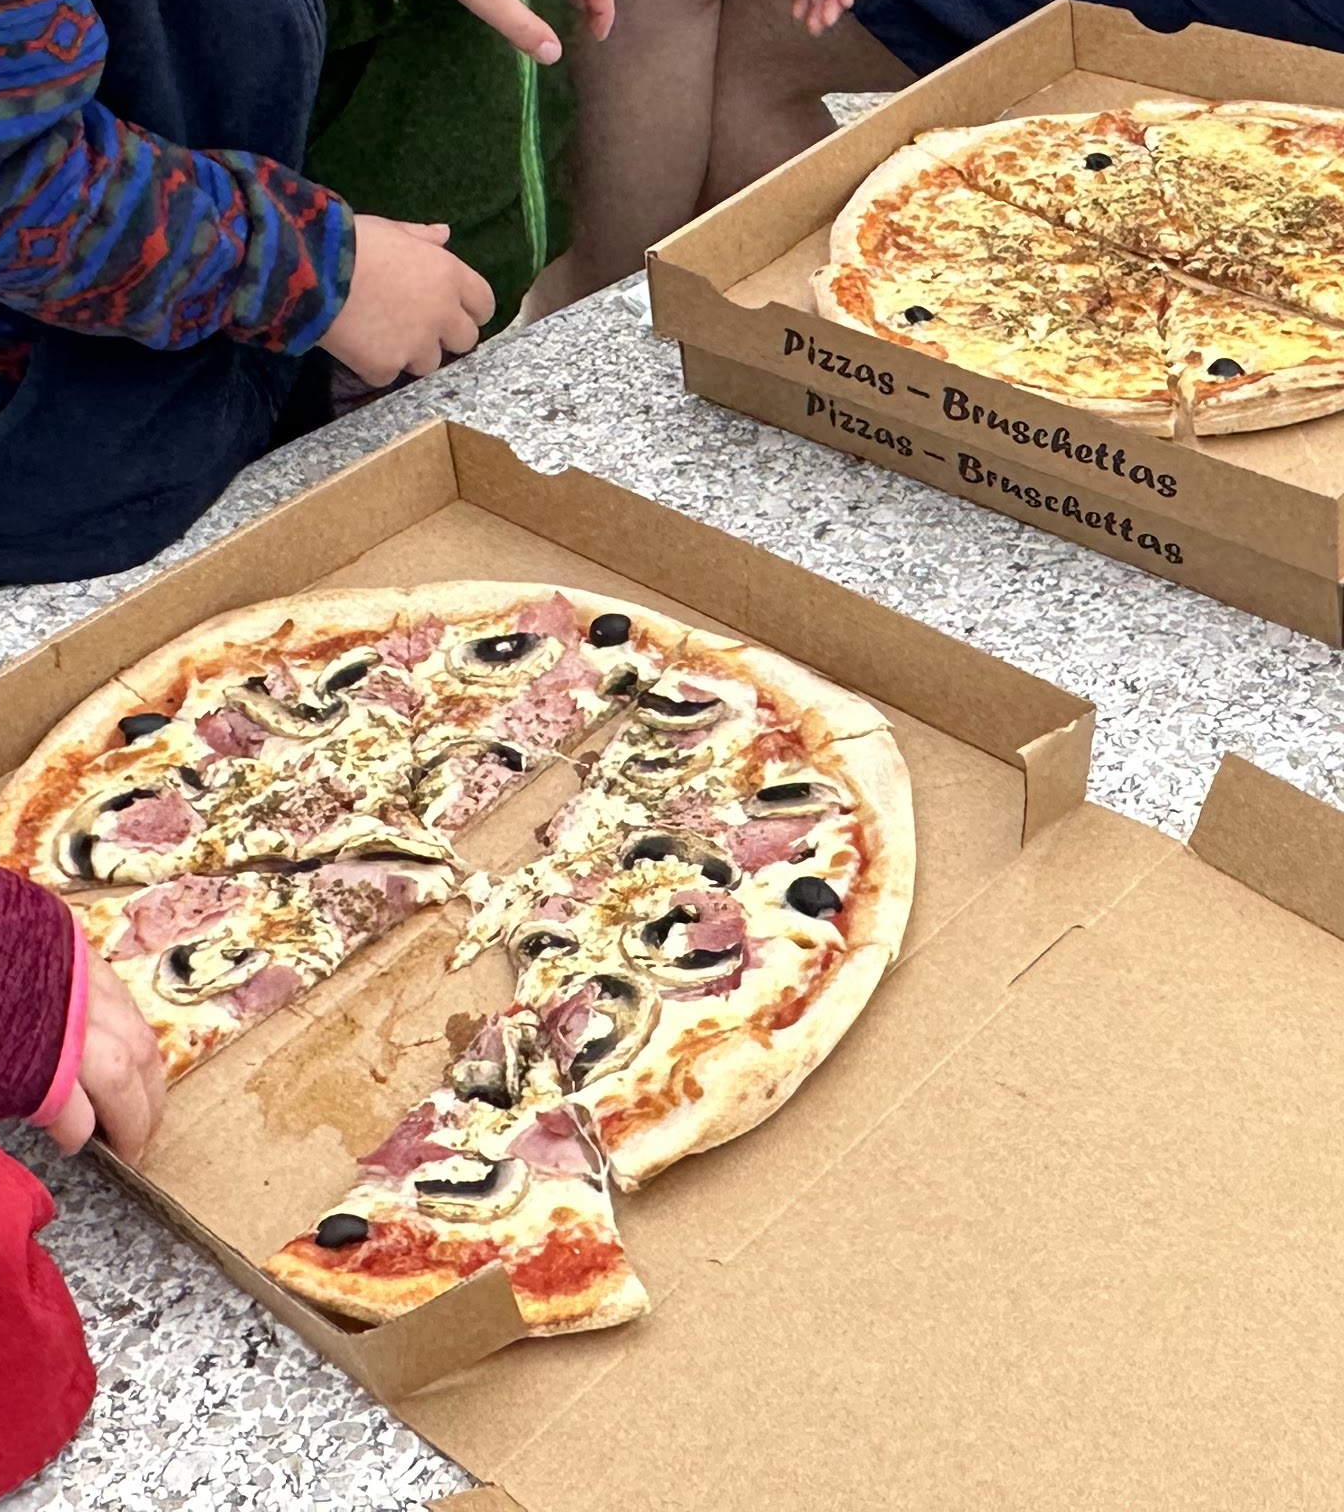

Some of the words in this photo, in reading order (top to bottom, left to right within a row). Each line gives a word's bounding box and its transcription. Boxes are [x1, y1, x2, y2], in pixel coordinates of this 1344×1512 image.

[783, 327, 895, 396] Pizzas
[942, 386, 1178, 498] Bruschettas
[805, 388, 914, 457] Pizzas
[957, 451, 1185, 565] Bruschettas
